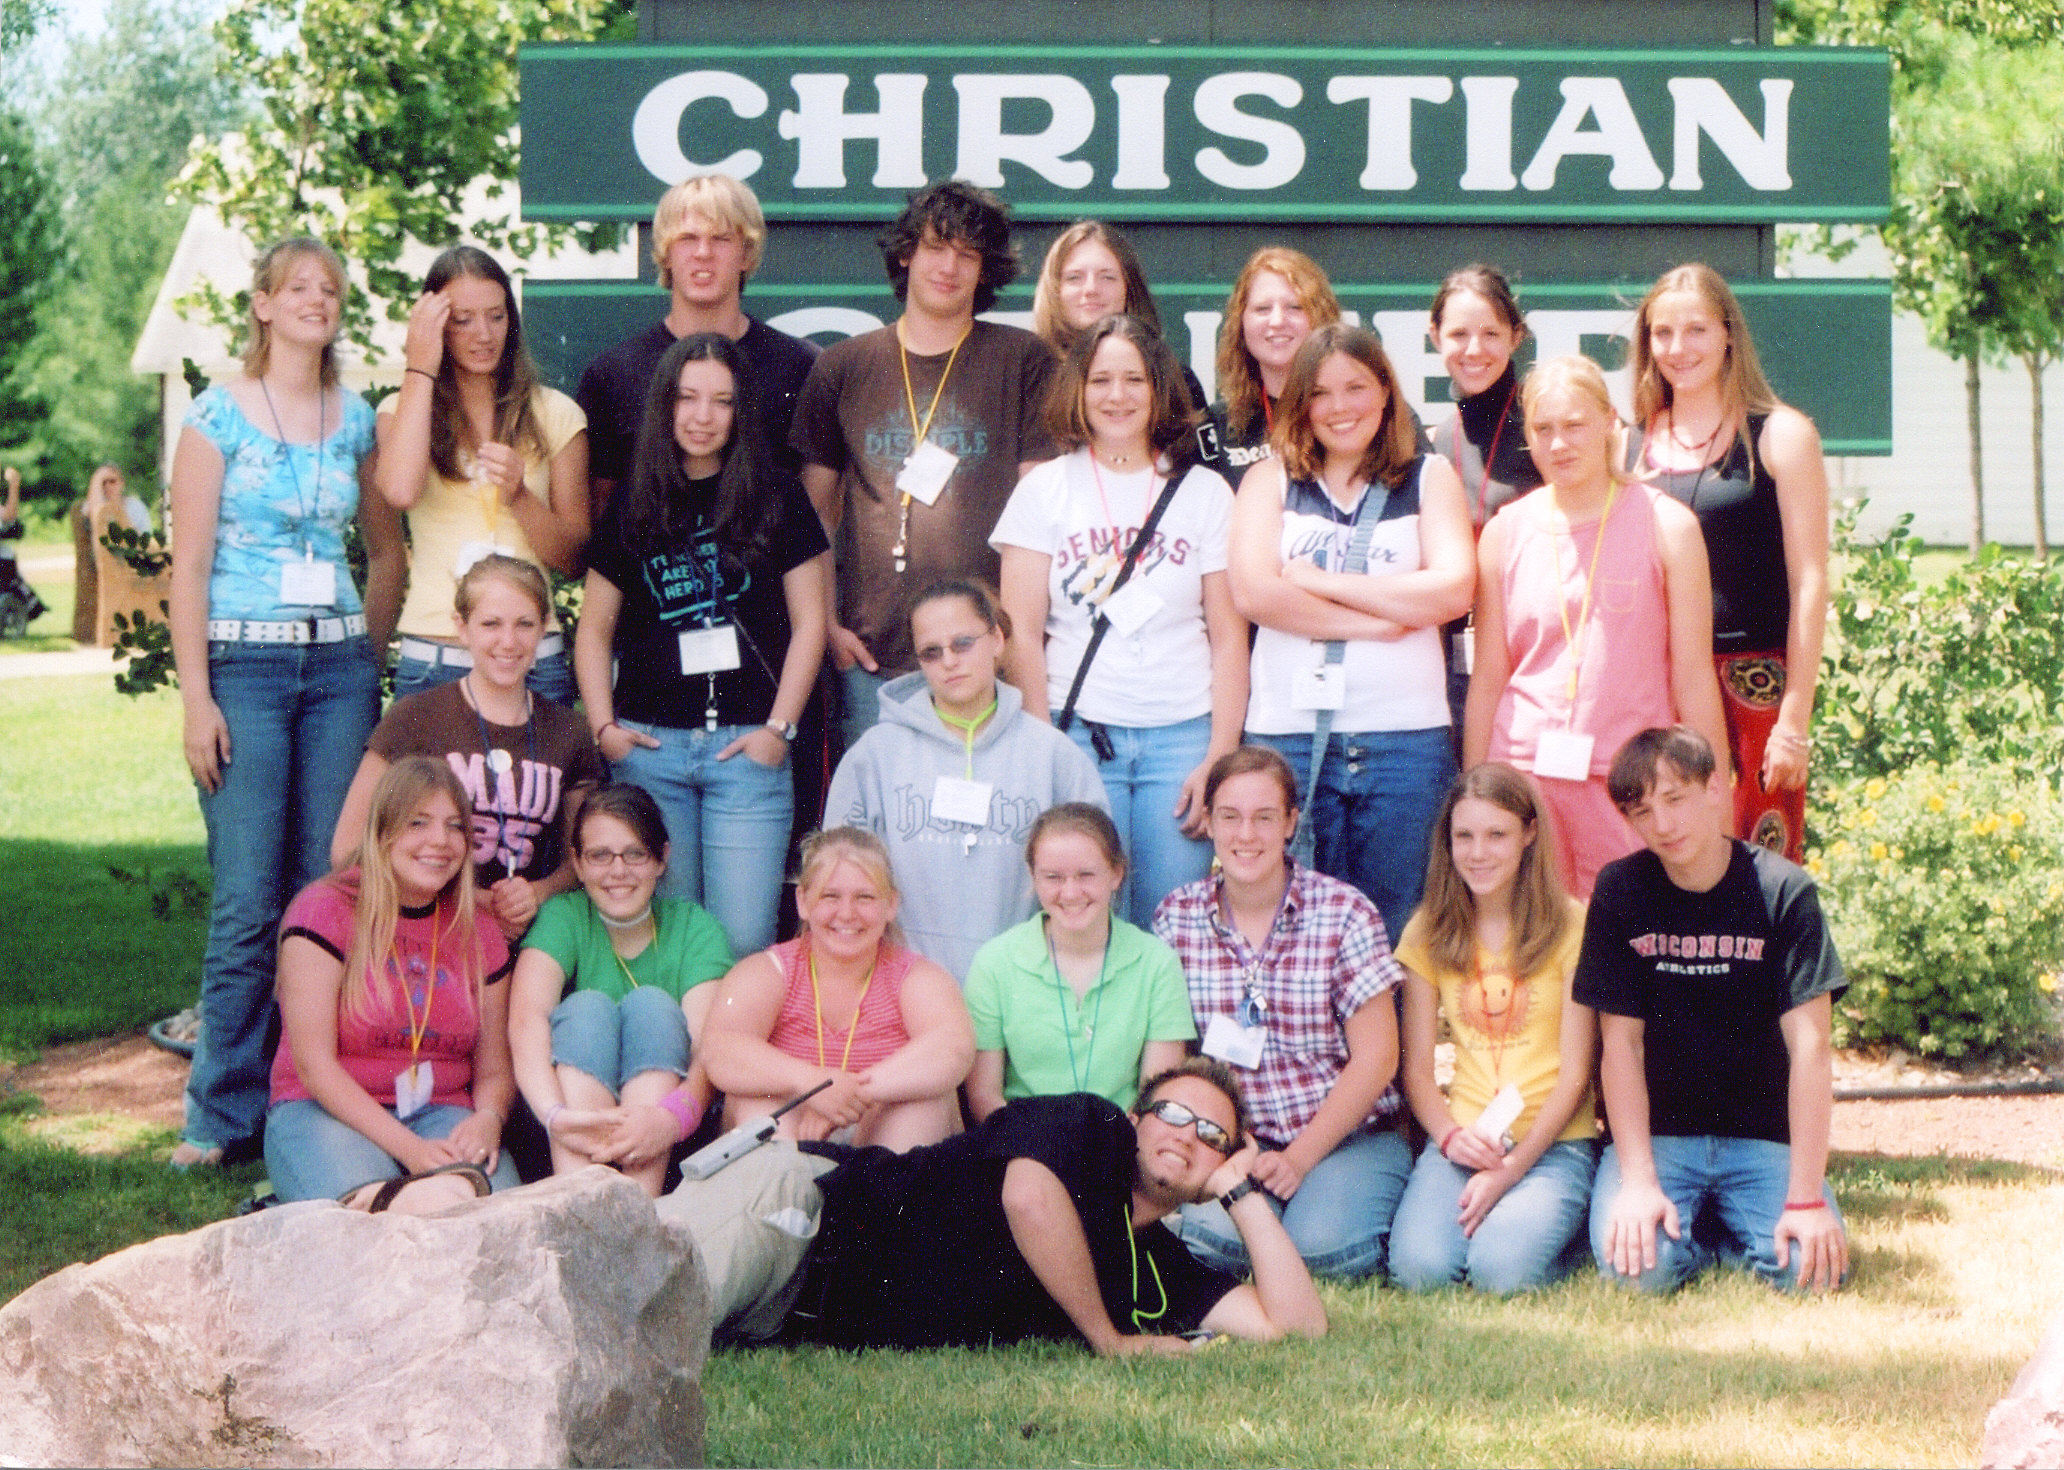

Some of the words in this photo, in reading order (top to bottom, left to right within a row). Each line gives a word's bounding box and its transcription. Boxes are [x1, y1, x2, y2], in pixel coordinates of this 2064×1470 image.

[632, 70, 1793, 192] CHRISTIAN
[865, 430, 988, 456] DISIPLE
[661, 564, 691, 584] ARE
[664, 575, 725, 601] HEROS
[1655, 961, 1731, 976] ATHLETICS
